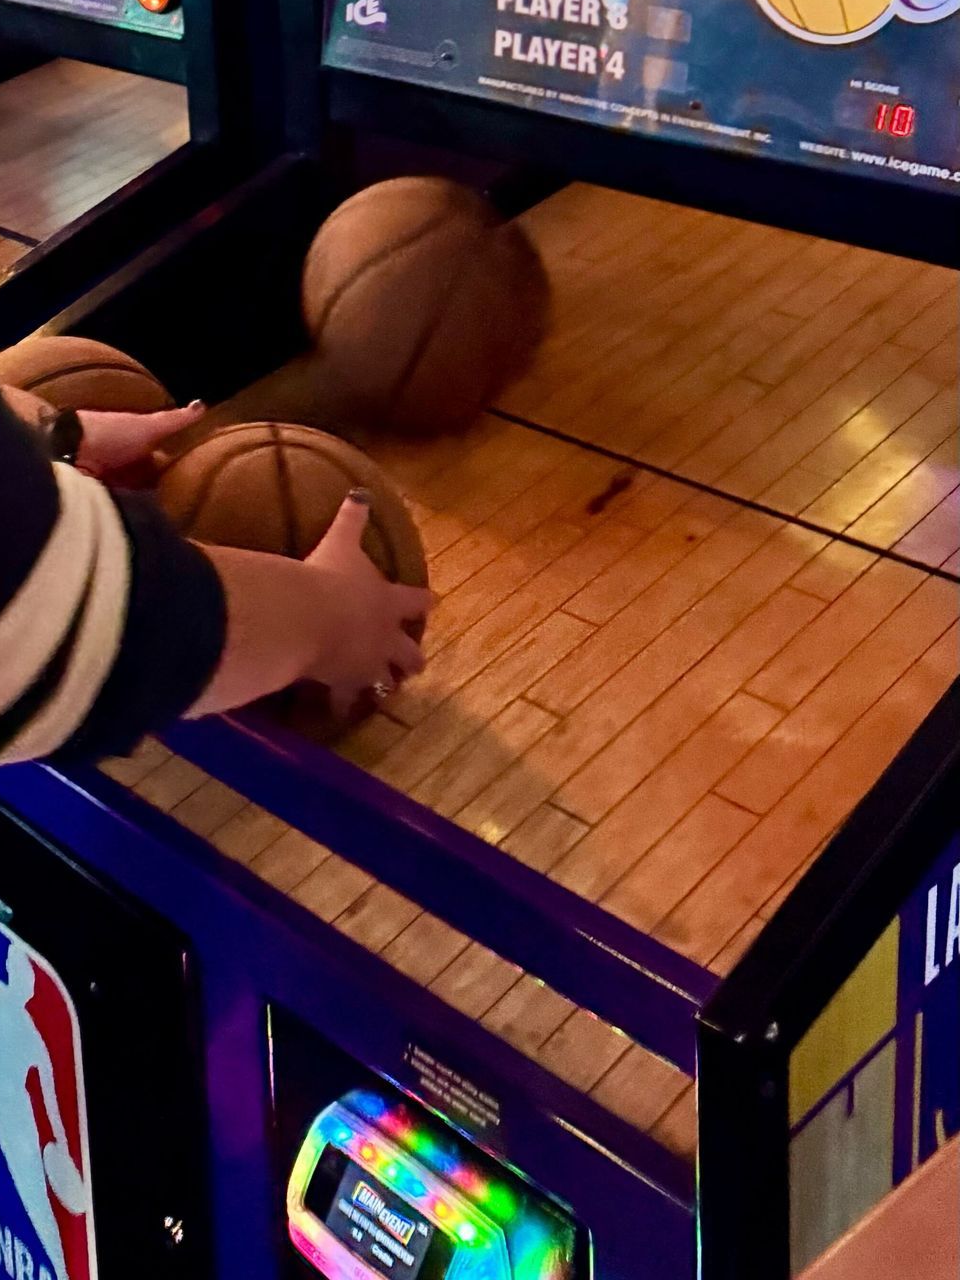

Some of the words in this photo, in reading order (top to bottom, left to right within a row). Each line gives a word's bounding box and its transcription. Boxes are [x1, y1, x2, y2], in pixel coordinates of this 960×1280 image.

[493, 29, 598, 74] PLAYER
[605, 51, 626, 80] 4
[876, 104, 914, 137] 10
[358, 1188, 386, 1215] MAIN
[379, 1207, 412, 1237] EVENT
